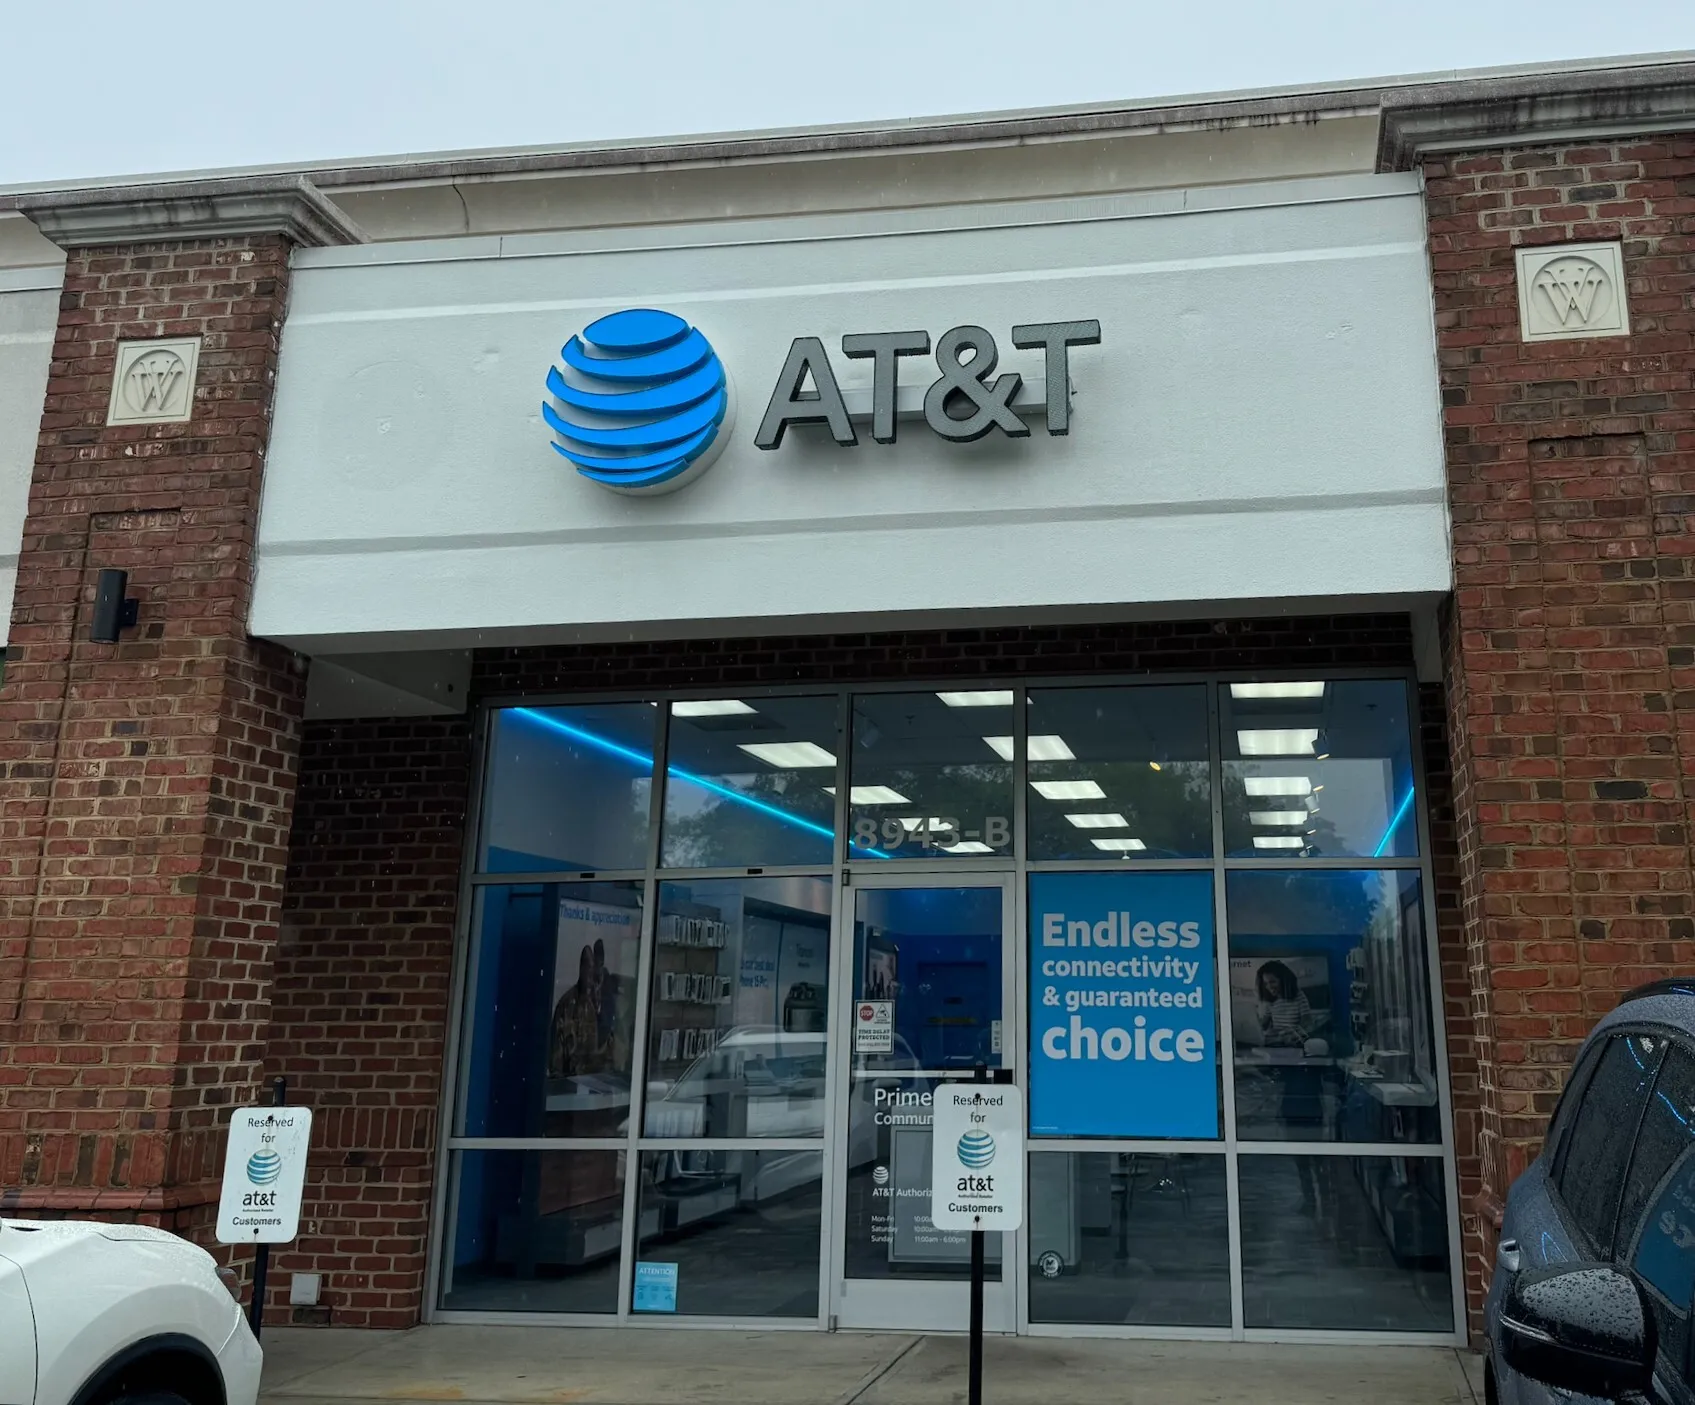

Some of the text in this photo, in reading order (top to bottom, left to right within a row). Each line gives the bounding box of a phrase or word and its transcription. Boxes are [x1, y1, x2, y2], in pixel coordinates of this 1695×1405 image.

[754, 318, 1101, 450] AT&T
[854, 816, 1011, 850] 8943-B
[1042, 911, 1201, 949] Endless
[1042, 955, 1200, 985] connectivity
[1042, 985, 1204, 1012] & guaranteed
[1042, 1015, 1205, 1063] choice
[874, 1087, 932, 1107] Prime
[953, 1095, 1003, 1106] Reserved
[247, 1117, 294, 1128] Reserved
[970, 1112, 986, 1123] for
[261, 1133, 276, 1143] for
[957, 1175, 994, 1192] at&t
[242, 1190, 277, 1206] at&t
[872, 1188, 895, 1197] AT&T
[948, 1203, 1004, 1213] Customers
[232, 1216, 282, 1225] Customers
[871, 1235, 894, 1244] Sunday
